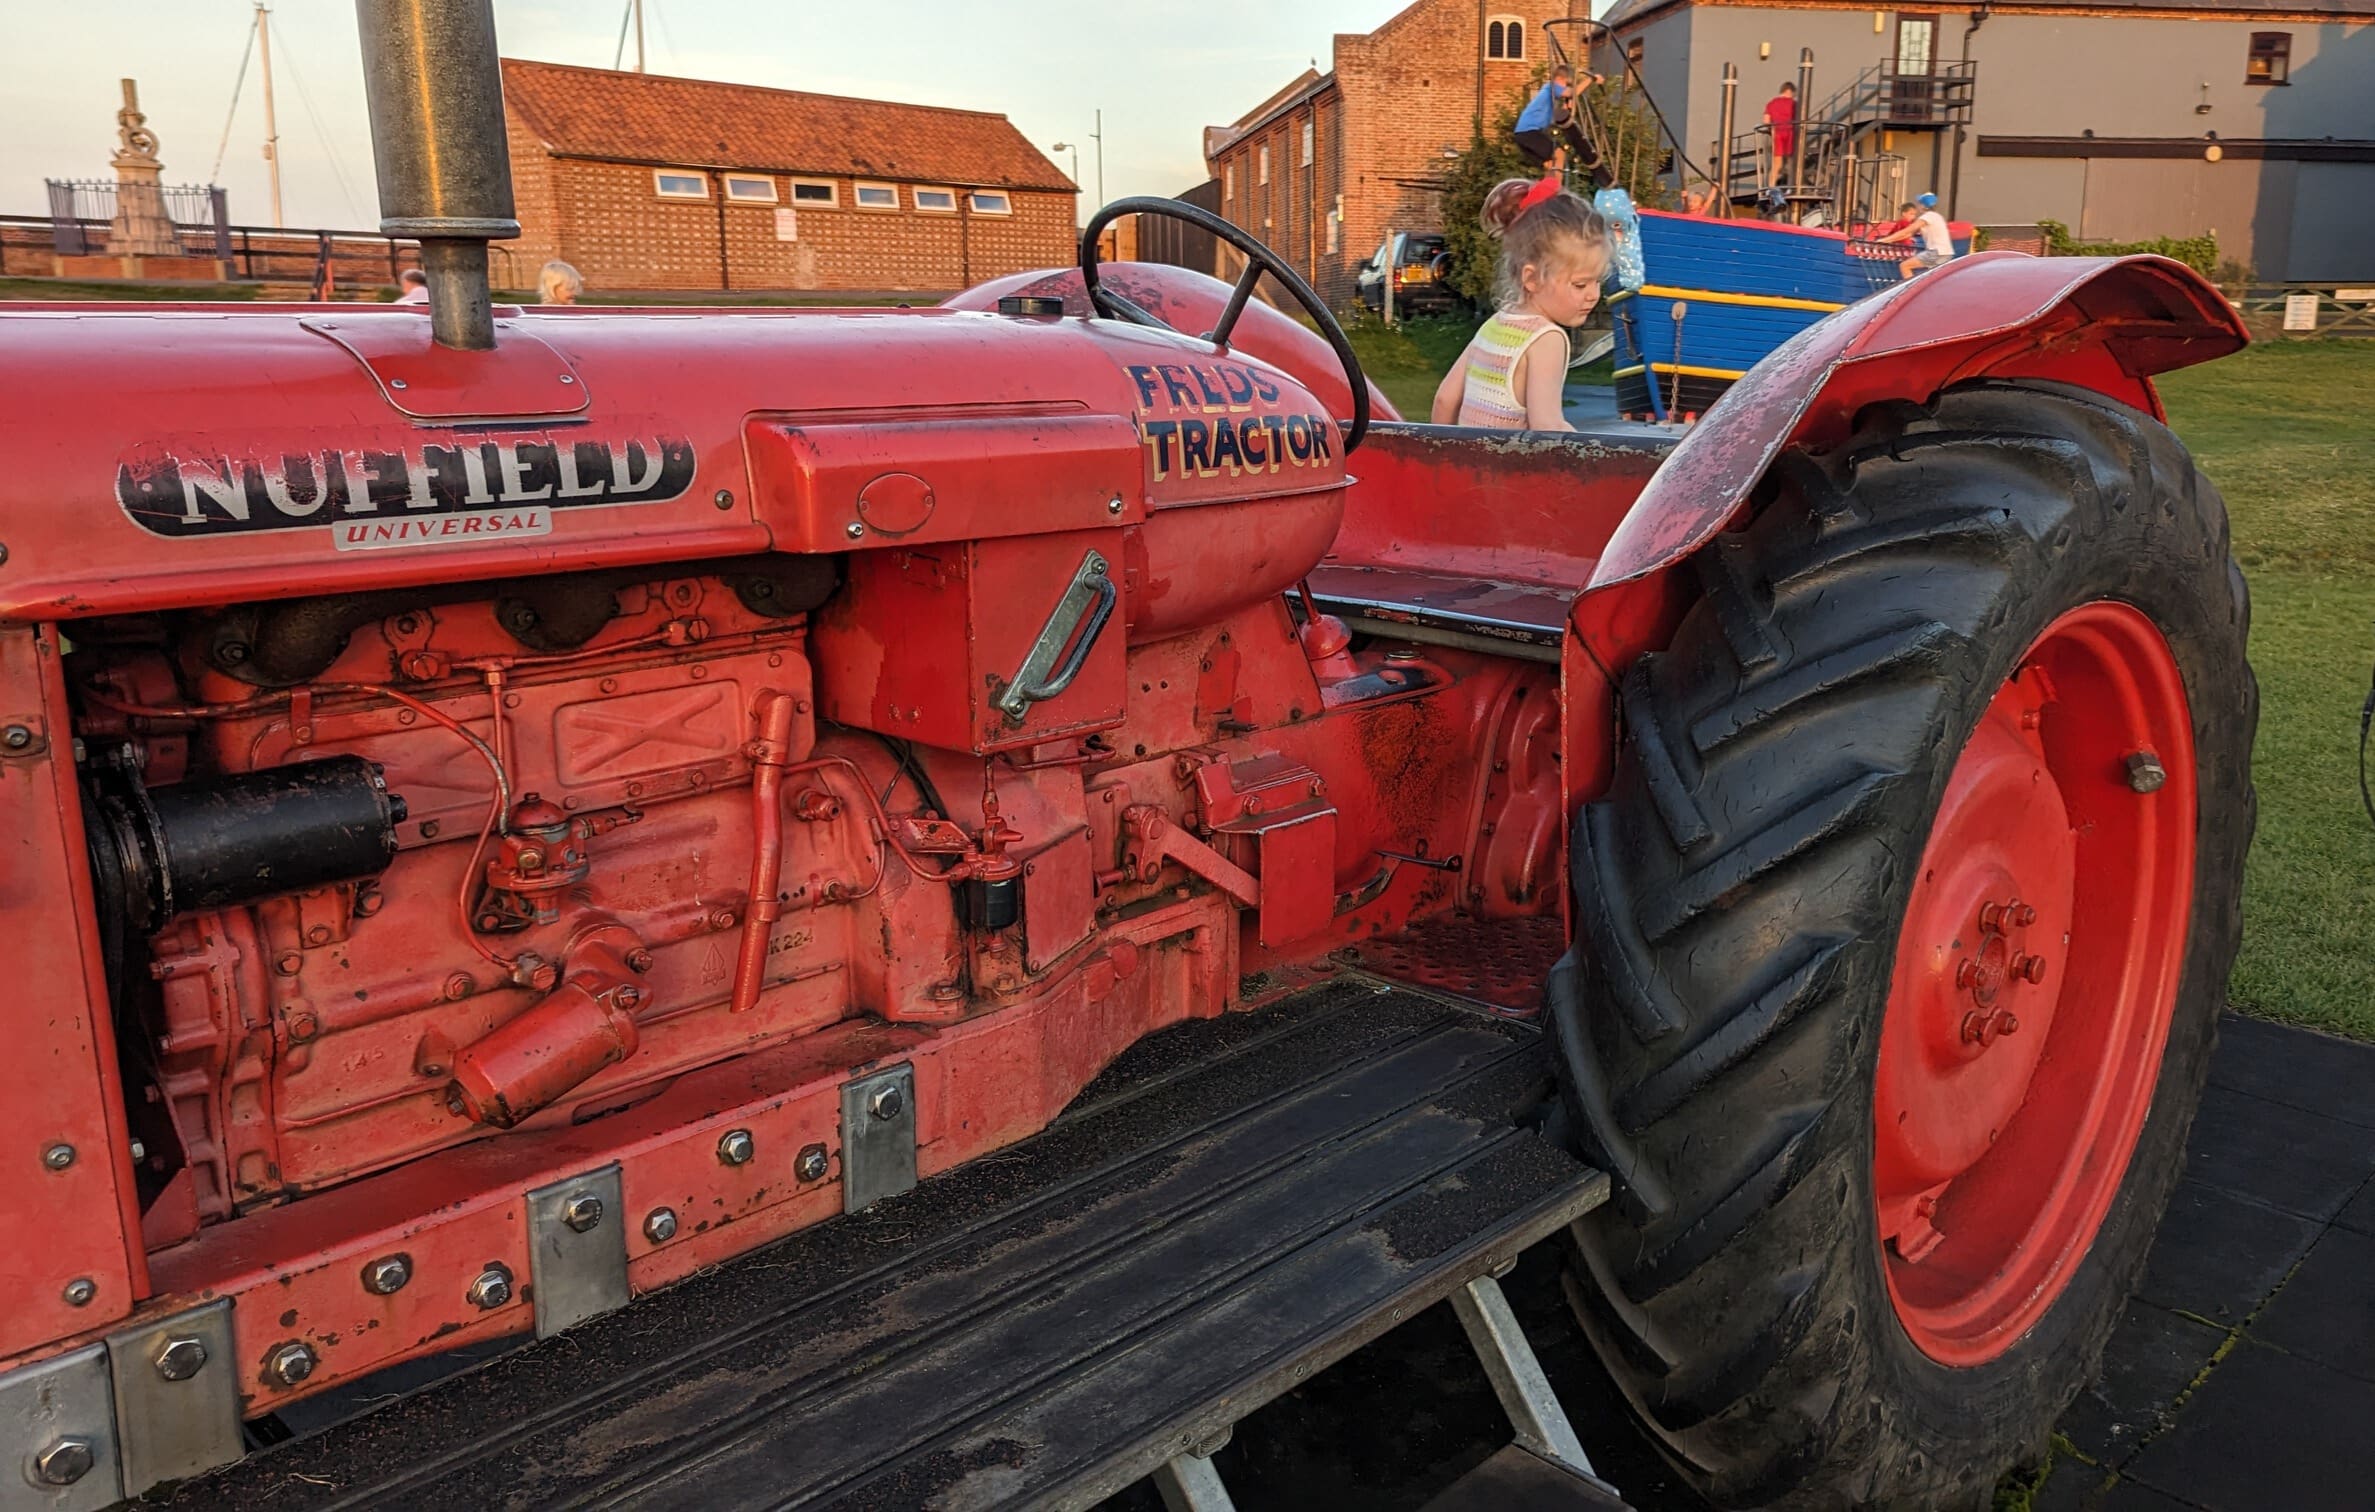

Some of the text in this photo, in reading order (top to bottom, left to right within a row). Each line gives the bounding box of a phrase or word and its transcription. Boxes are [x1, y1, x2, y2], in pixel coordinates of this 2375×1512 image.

[174, 430, 665, 525] NUFFIELD
[1141, 412, 1332, 482] TRACTOR
[346, 512, 543, 543] UNIVERSAL
